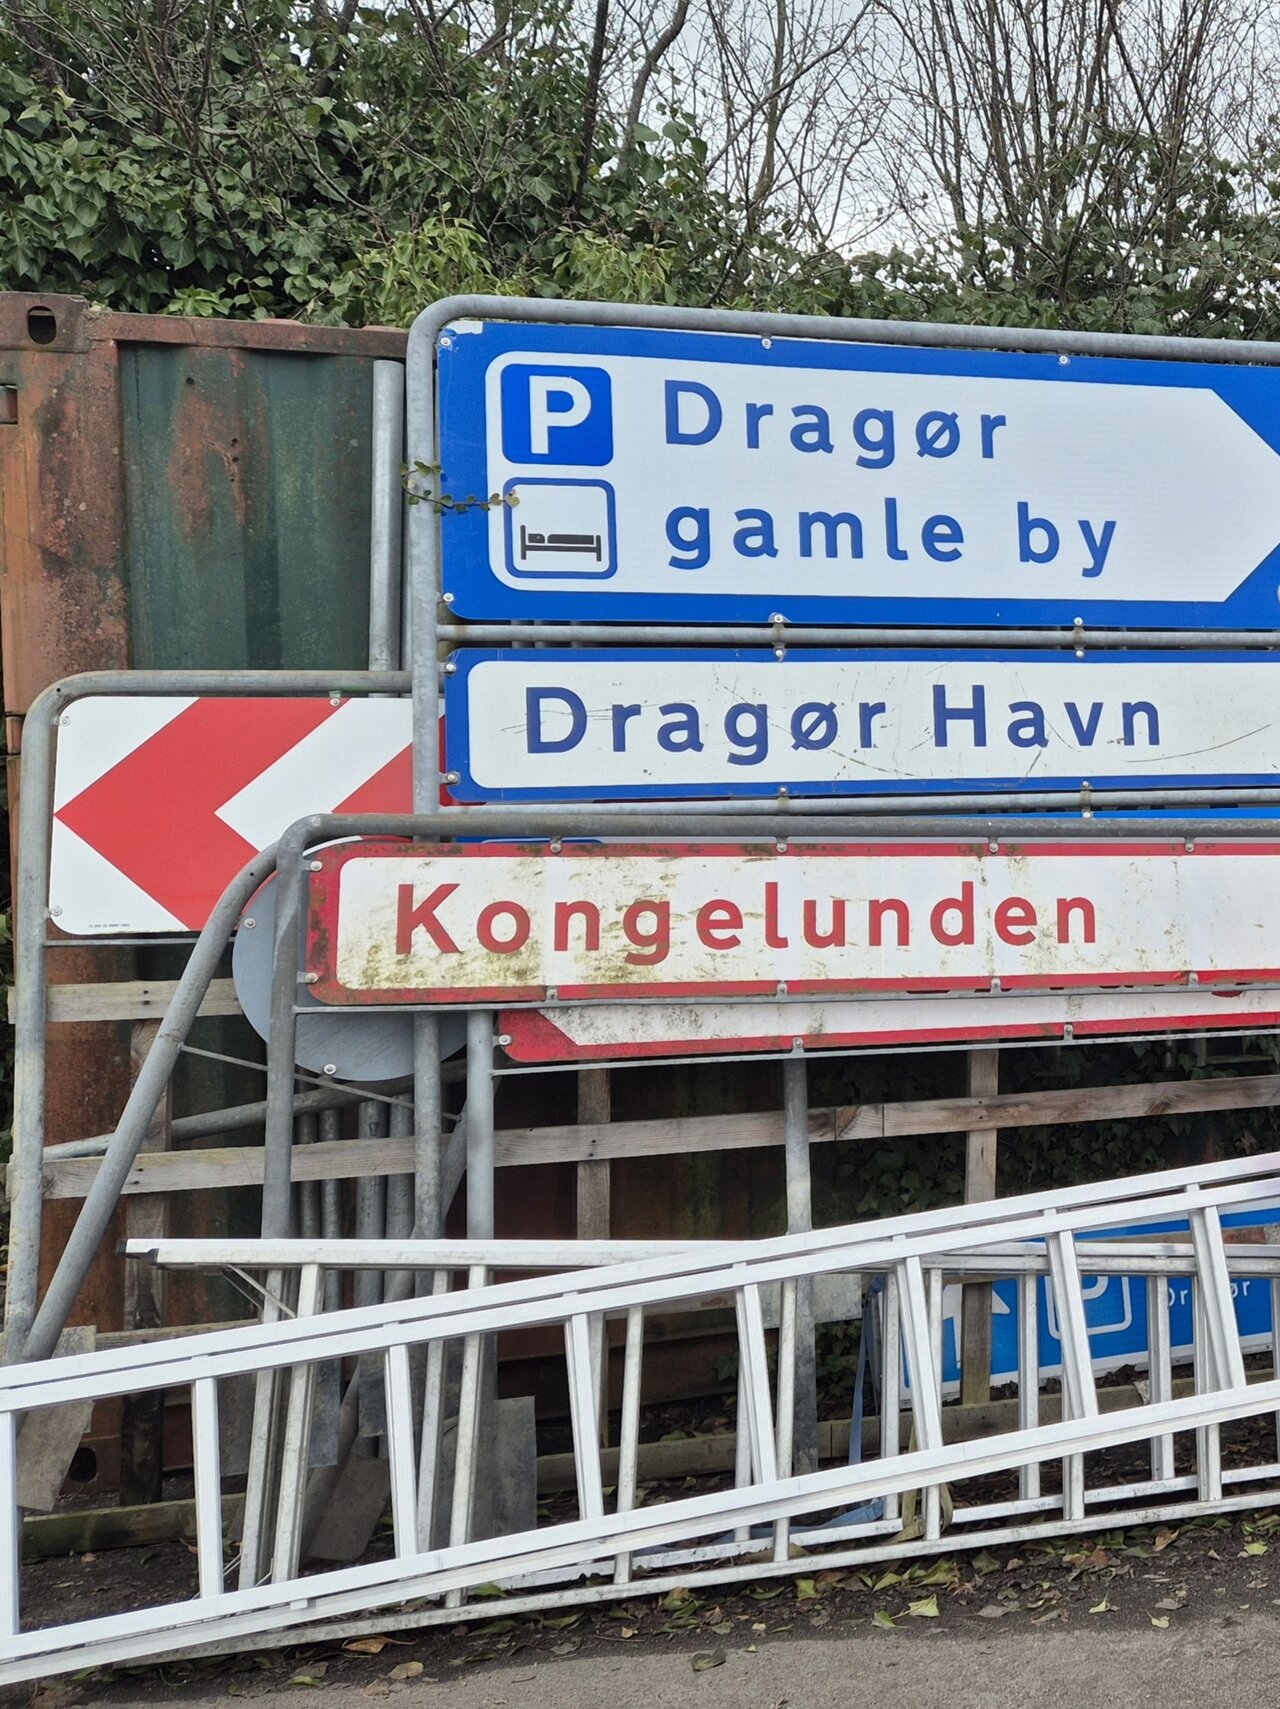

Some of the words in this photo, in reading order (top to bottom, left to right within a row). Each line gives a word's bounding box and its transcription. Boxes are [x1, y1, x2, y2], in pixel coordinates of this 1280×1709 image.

[530, 375, 591, 454] P
[664, 379, 1007, 470] Dragør
[665, 496, 965, 571] gamle
[1017, 501, 1117, 579] by
[526, 687, 886, 766] Dragør
[934, 685, 1160, 747] Havn
[396, 881, 1096, 965] Kongelunden
